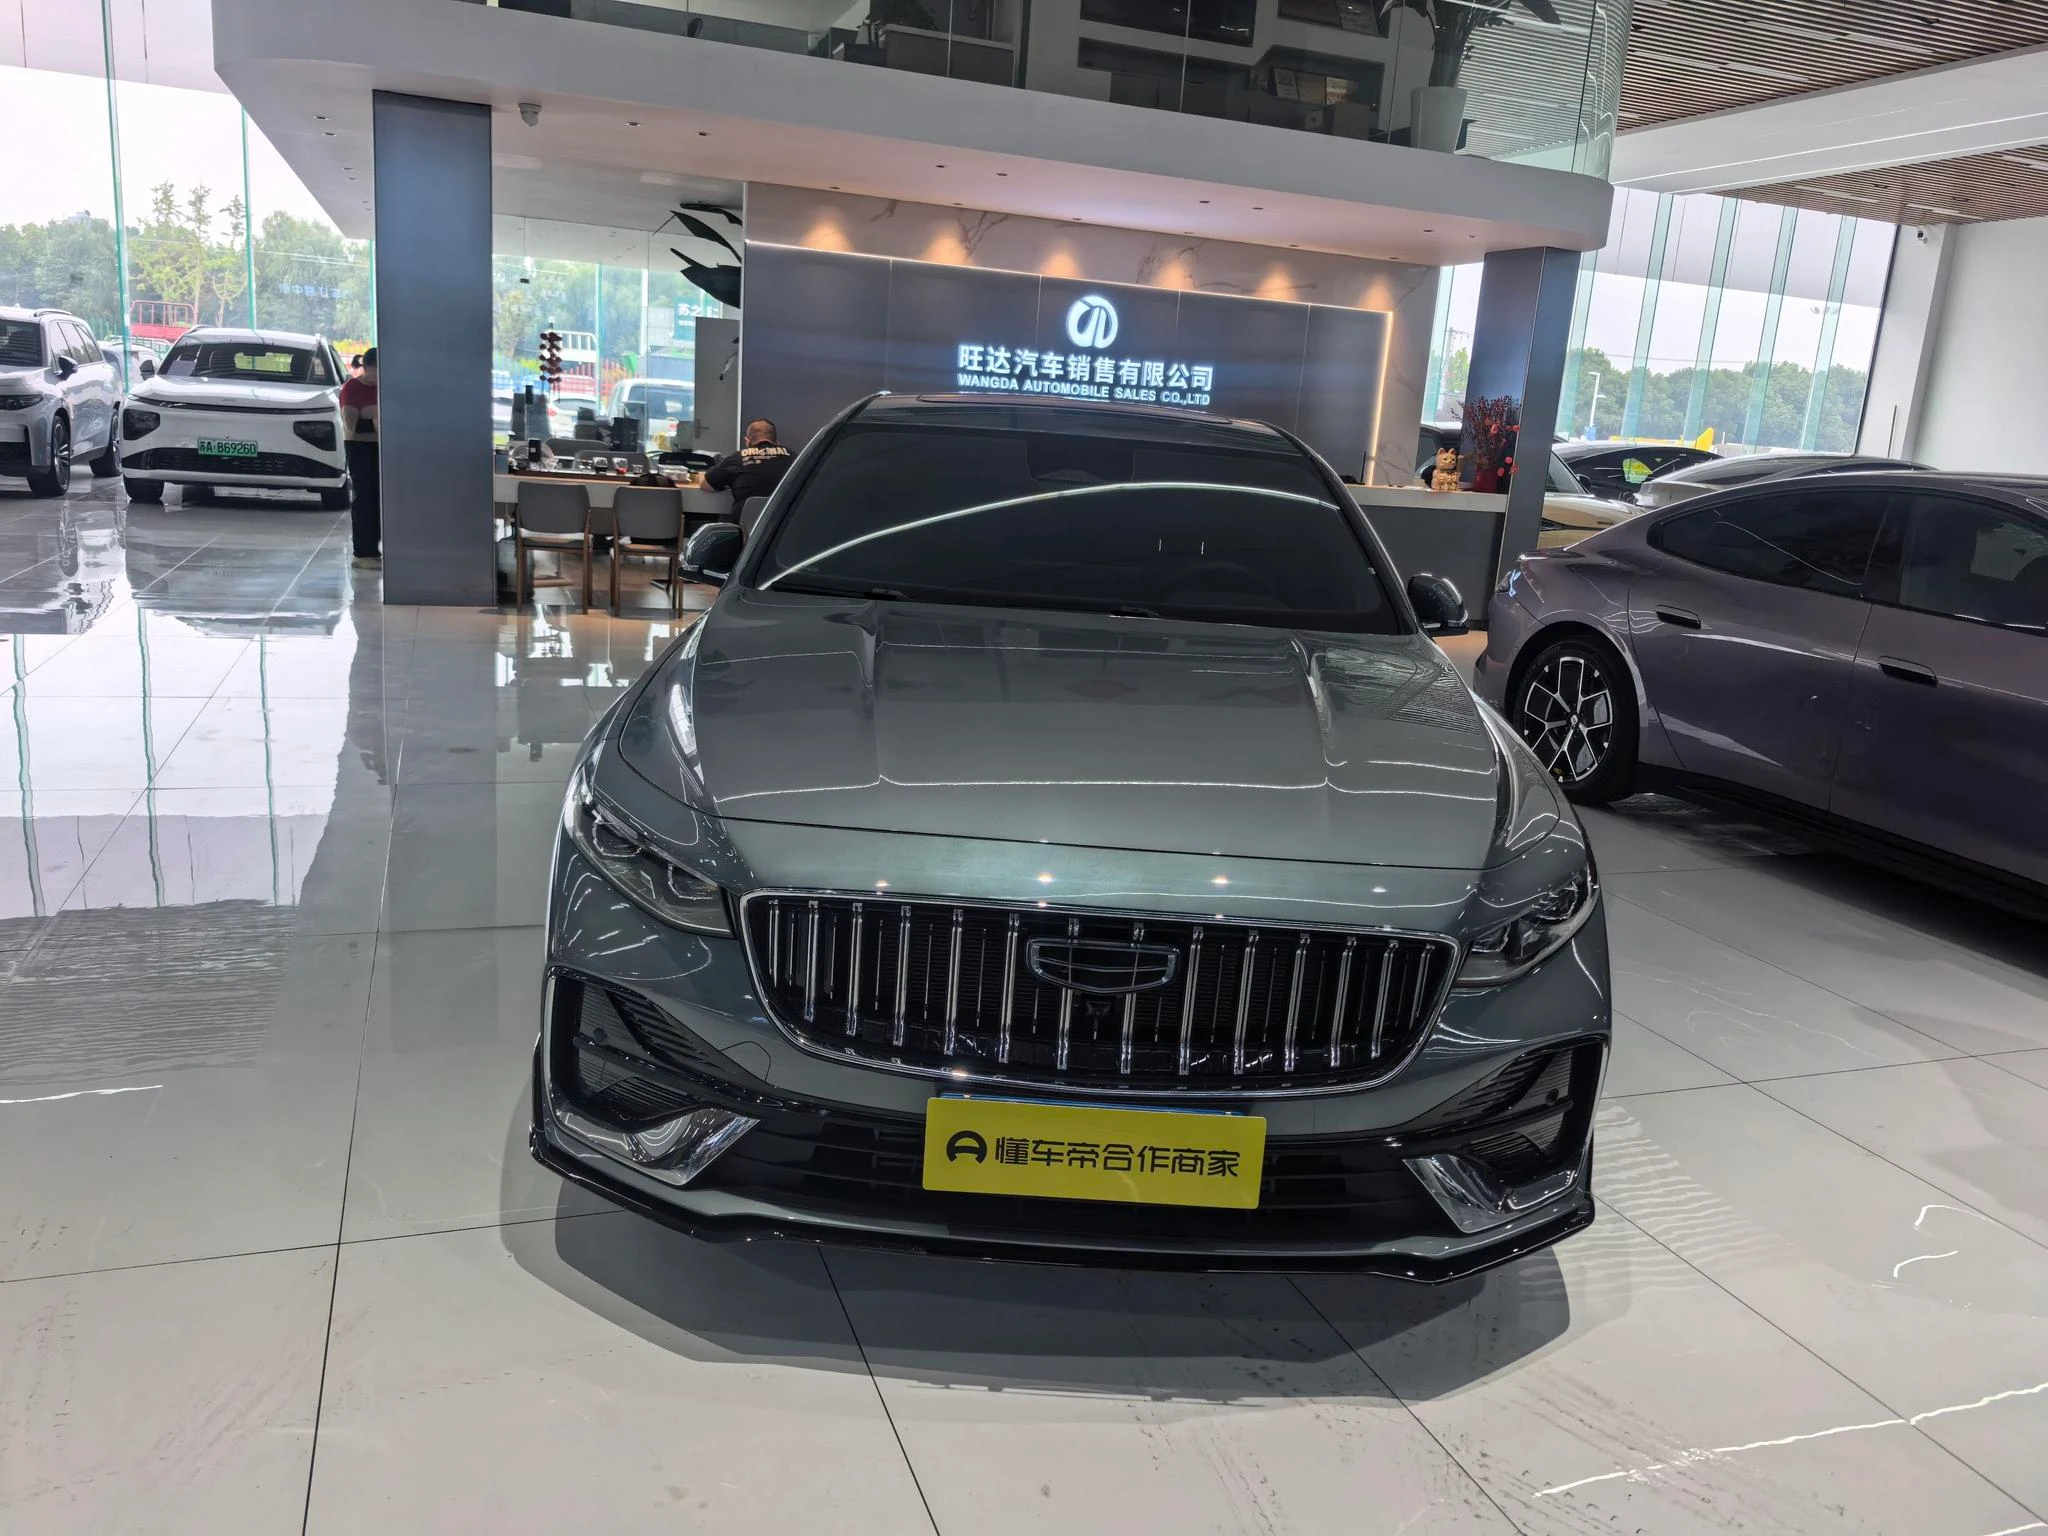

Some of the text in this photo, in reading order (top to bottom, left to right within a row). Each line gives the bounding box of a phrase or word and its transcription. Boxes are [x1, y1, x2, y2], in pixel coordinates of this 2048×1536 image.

[958, 344, 1214, 391] 旺达汽车销售有限公司
[958, 373, 1019, 391] WANGDA
[1022, 379, 1110, 398] AUTOMOBILE
[1115, 387, 1156, 402] SALES
[995, 1136, 1241, 1177] 懂车帝合作商家
